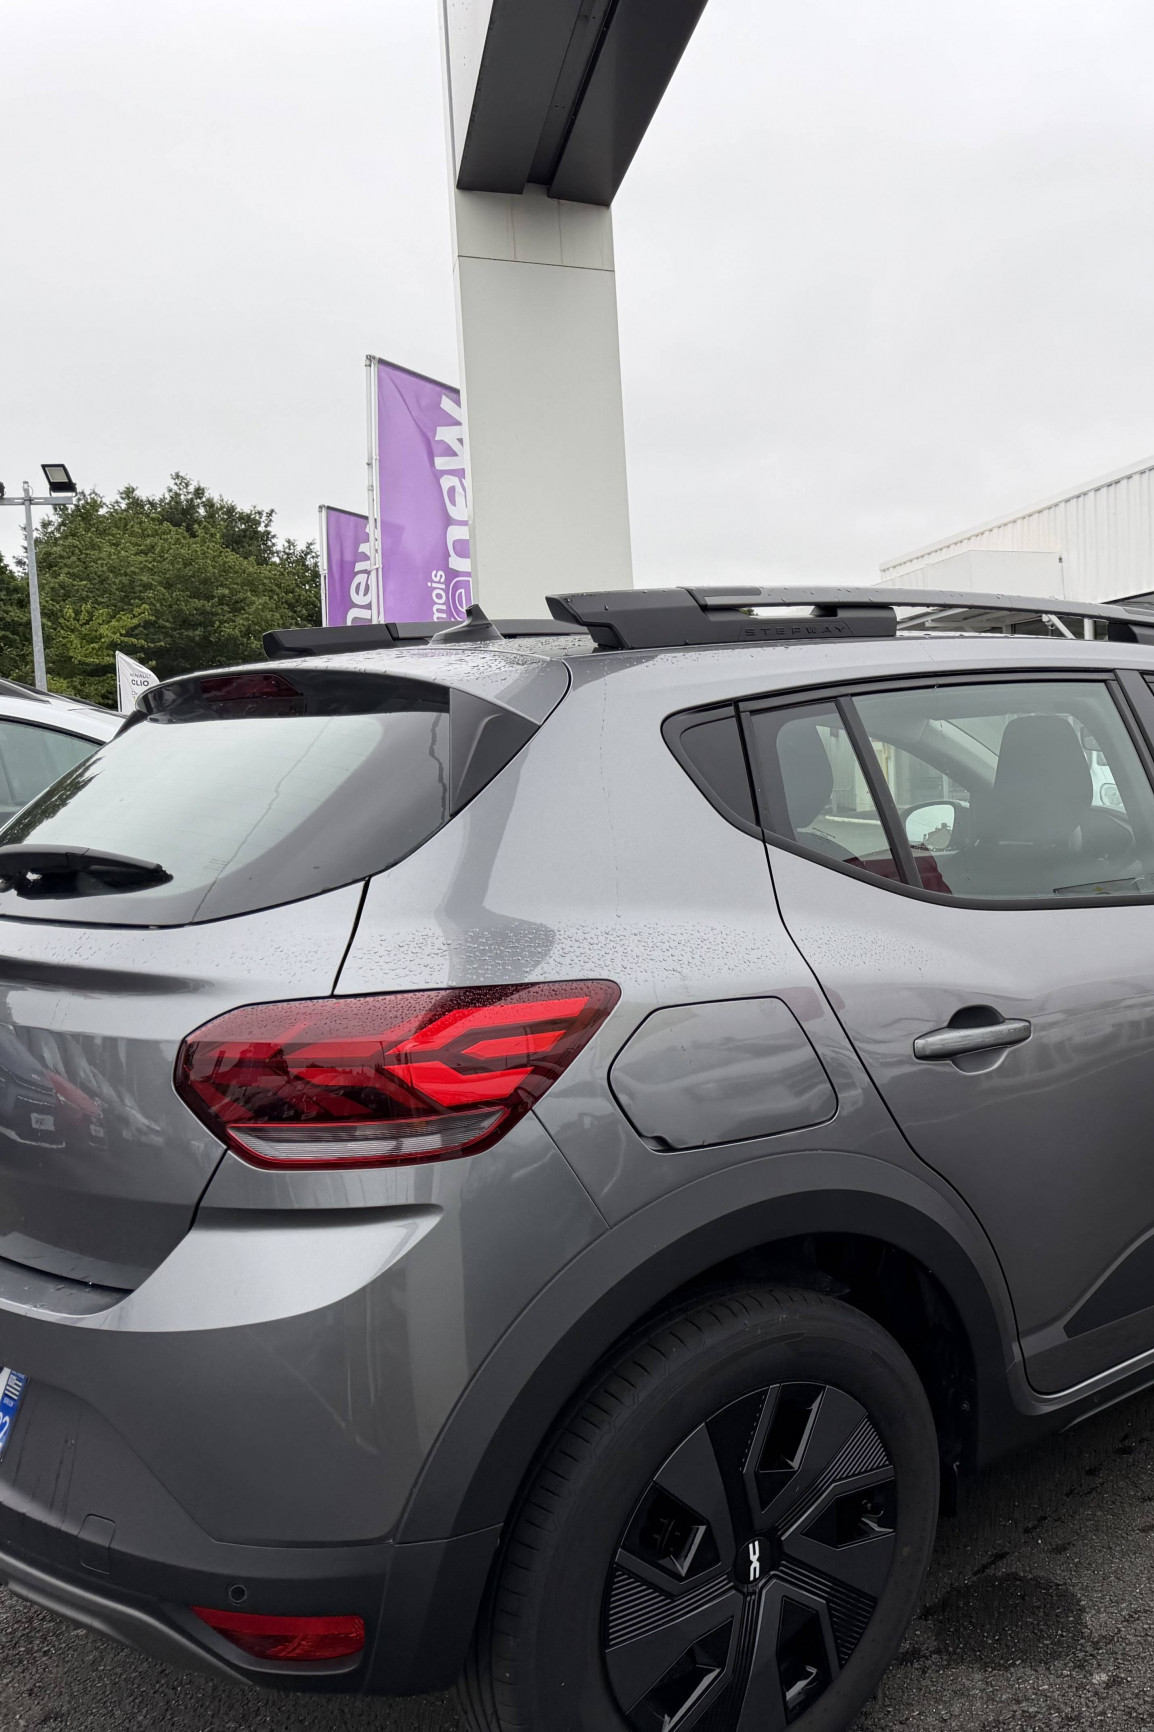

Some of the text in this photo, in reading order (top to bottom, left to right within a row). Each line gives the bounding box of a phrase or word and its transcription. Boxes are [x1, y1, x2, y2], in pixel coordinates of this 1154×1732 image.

[427, 570, 446, 622] mois
[745, 626, 845, 637] STEPWAY
[131, 679, 149, 687] CLIO
